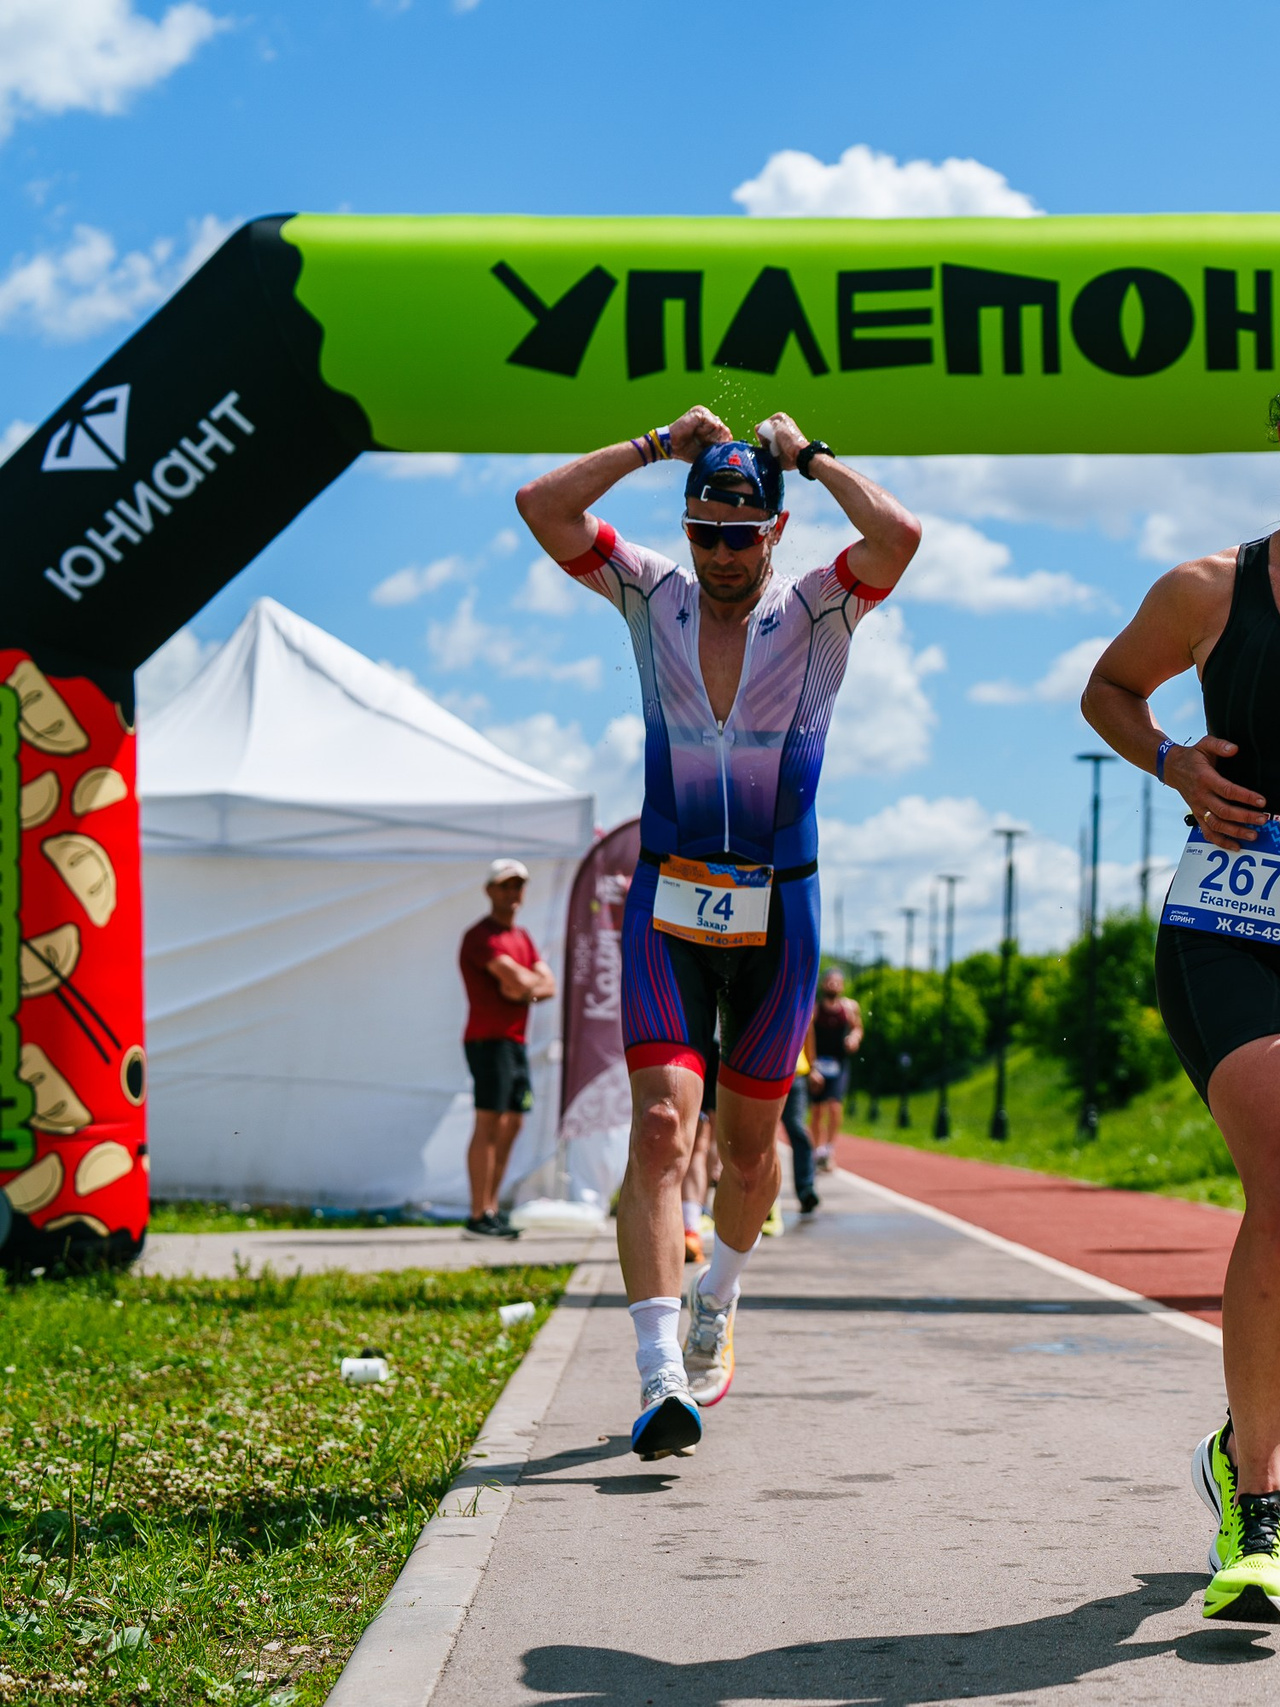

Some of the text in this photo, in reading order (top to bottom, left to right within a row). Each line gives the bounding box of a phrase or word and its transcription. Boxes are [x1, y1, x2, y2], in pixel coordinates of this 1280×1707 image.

[695, 887, 734, 921] 74
[1200, 891, 1276, 916] Екатерина
[696, 917, 728, 933] Захар
[1169, 914, 1196, 924] СПРИНТ
[1216, 917, 1232, 932] Ж
